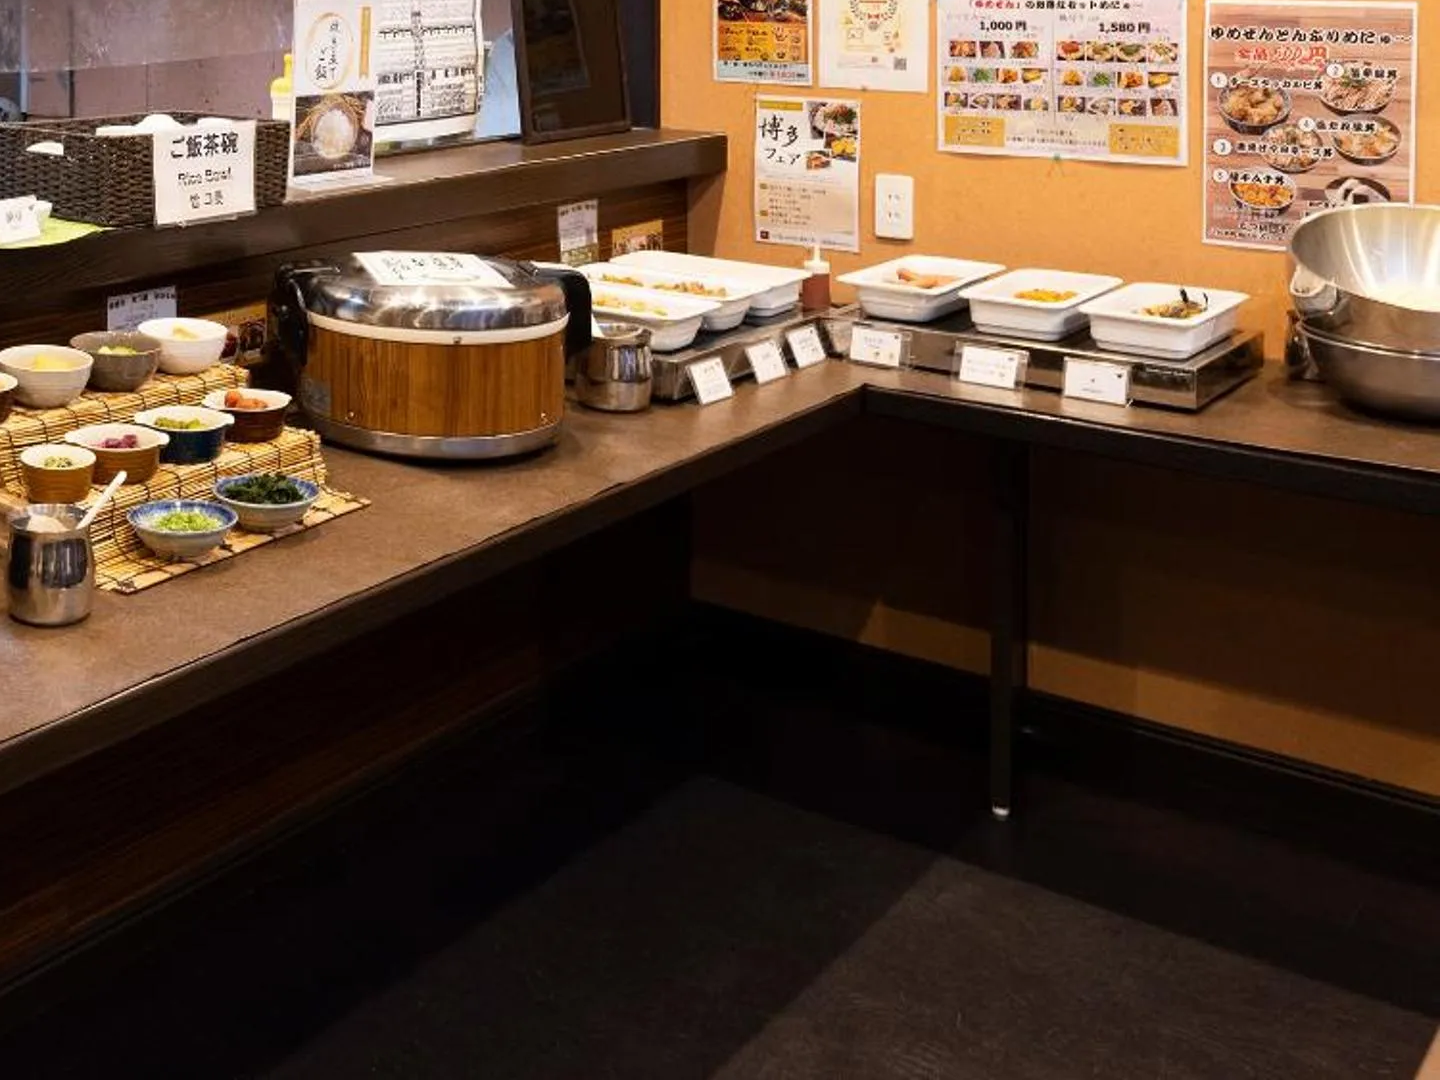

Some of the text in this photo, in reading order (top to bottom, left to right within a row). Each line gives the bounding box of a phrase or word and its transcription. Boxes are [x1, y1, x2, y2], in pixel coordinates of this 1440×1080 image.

[171, 131, 239, 159] ご飯茶碗
[759, 114, 800, 148] 博多
[764, 148, 801, 166] フェア
